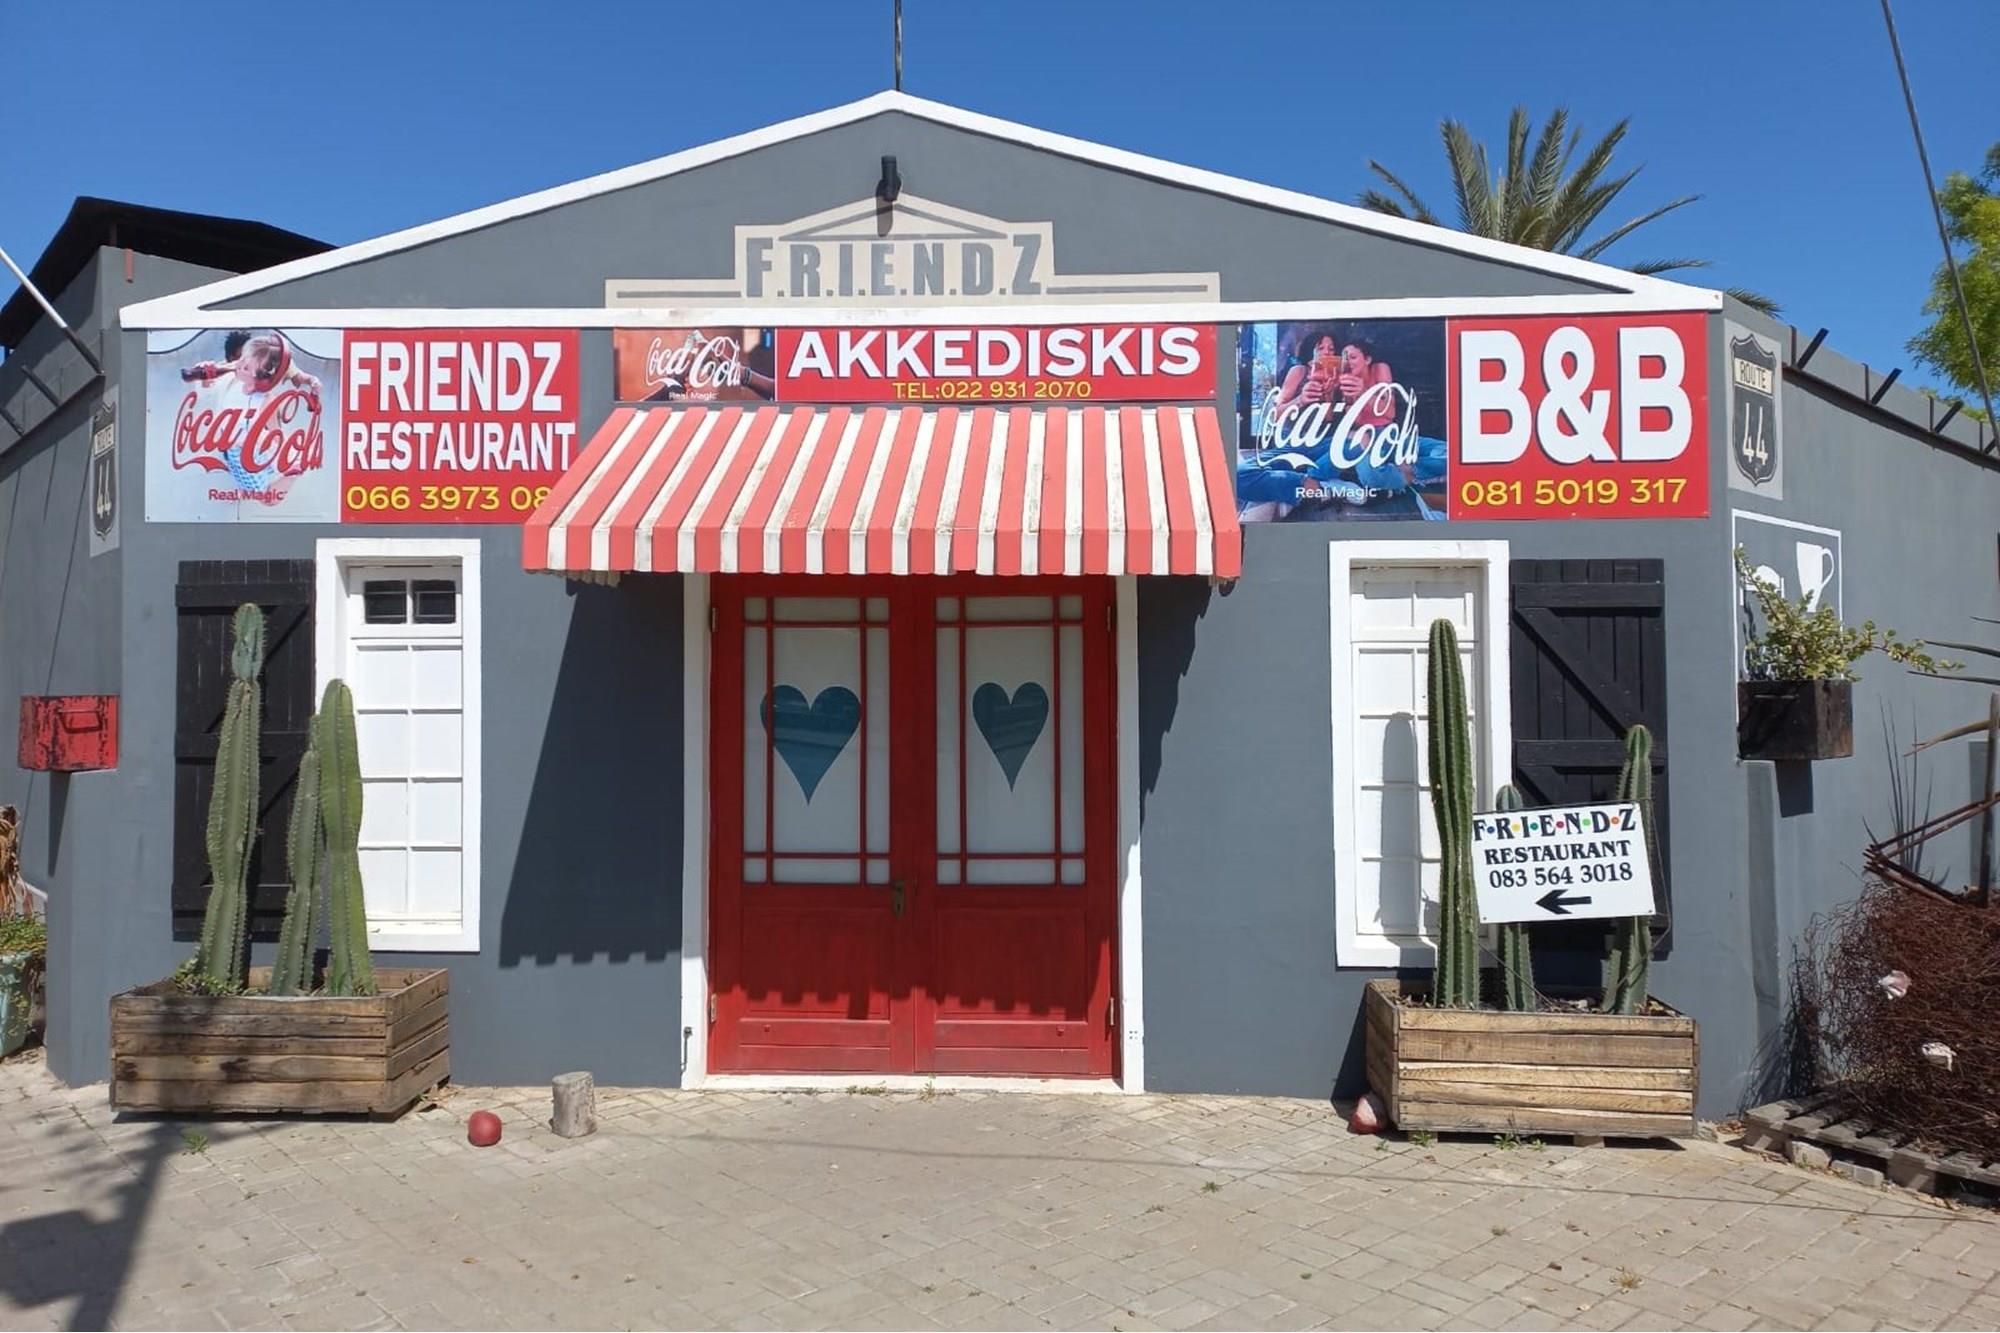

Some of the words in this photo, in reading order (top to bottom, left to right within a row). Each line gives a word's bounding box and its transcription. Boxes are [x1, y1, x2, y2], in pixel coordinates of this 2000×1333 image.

[645, 336, 741, 388] Coca-Cola
[787, 326, 1201, 378] AKKEDISKIS
[349, 341, 562, 412] FRIENDZ
[989, 381, 1026, 399] 931
[1034, 381, 1091, 399] 2070
[1740, 360, 1767, 389] ROUTE
[1460, 326, 1693, 464] B&B
[172, 390, 324, 474] Coca-Cola
[1256, 382, 1419, 469] Coca-Cola
[1743, 402, 1768, 466] 44
[347, 420, 577, 472] RESTAURANT
[208, 488, 238, 501] Real
[242, 488, 285, 503] Magic
[346, 485, 410, 511] 066
[419, 485, 500, 511] 3973
[1295, 486, 1327, 498] Real
[1332, 486, 1377, 501] Magic
[1461, 481, 1522, 506] 081
[1535, 479, 1618, 505] 5019
[1630, 478, 1688, 504] 317
[1485, 840, 1631, 865] RESTAURANT
[1489, 868, 1528, 889] 083
[1534, 866, 1574, 886] 564
[1580, 862, 1634, 884] 3018
